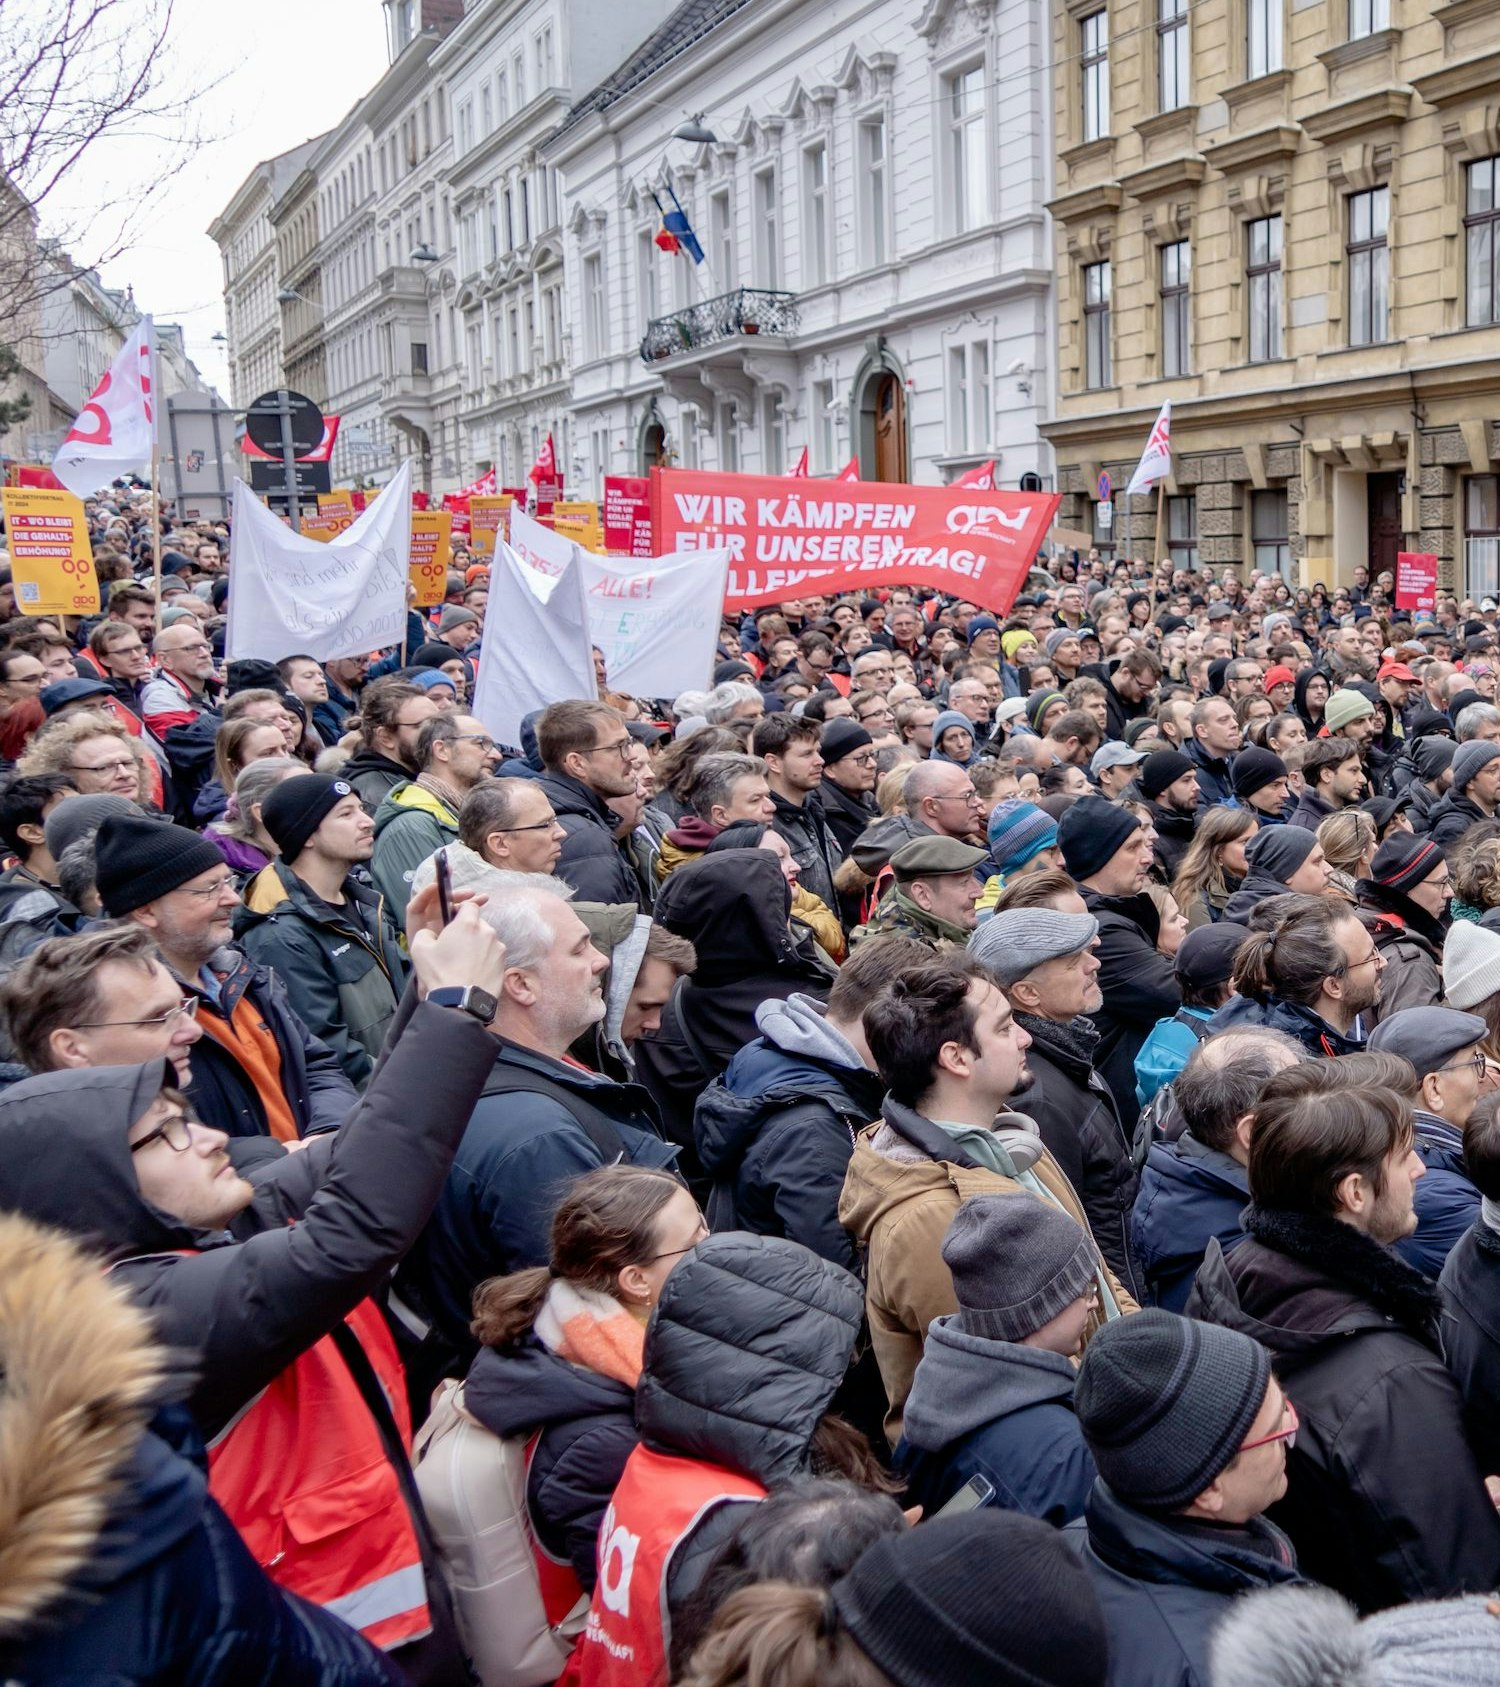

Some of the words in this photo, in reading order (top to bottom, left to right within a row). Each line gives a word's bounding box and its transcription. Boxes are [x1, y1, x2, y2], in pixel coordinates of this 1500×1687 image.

[674, 494, 747, 526] WIR
[757, 494, 916, 530] KÄMPFEN
[12, 517, 20, 525] IT
[27, 517, 44, 526] WO
[45, 518, 72, 526] BLEIBT
[14, 532, 28, 540] DIE
[30, 532, 72, 542] GEHALTS-
[675, 526, 746, 560] FÜR
[756, 534, 905, 562] UNSEREN
[16, 546, 71, 556] ERHÖHUNG?
[590, 577, 656, 600] ALLE!
[73, 596, 96, 608] gpa
